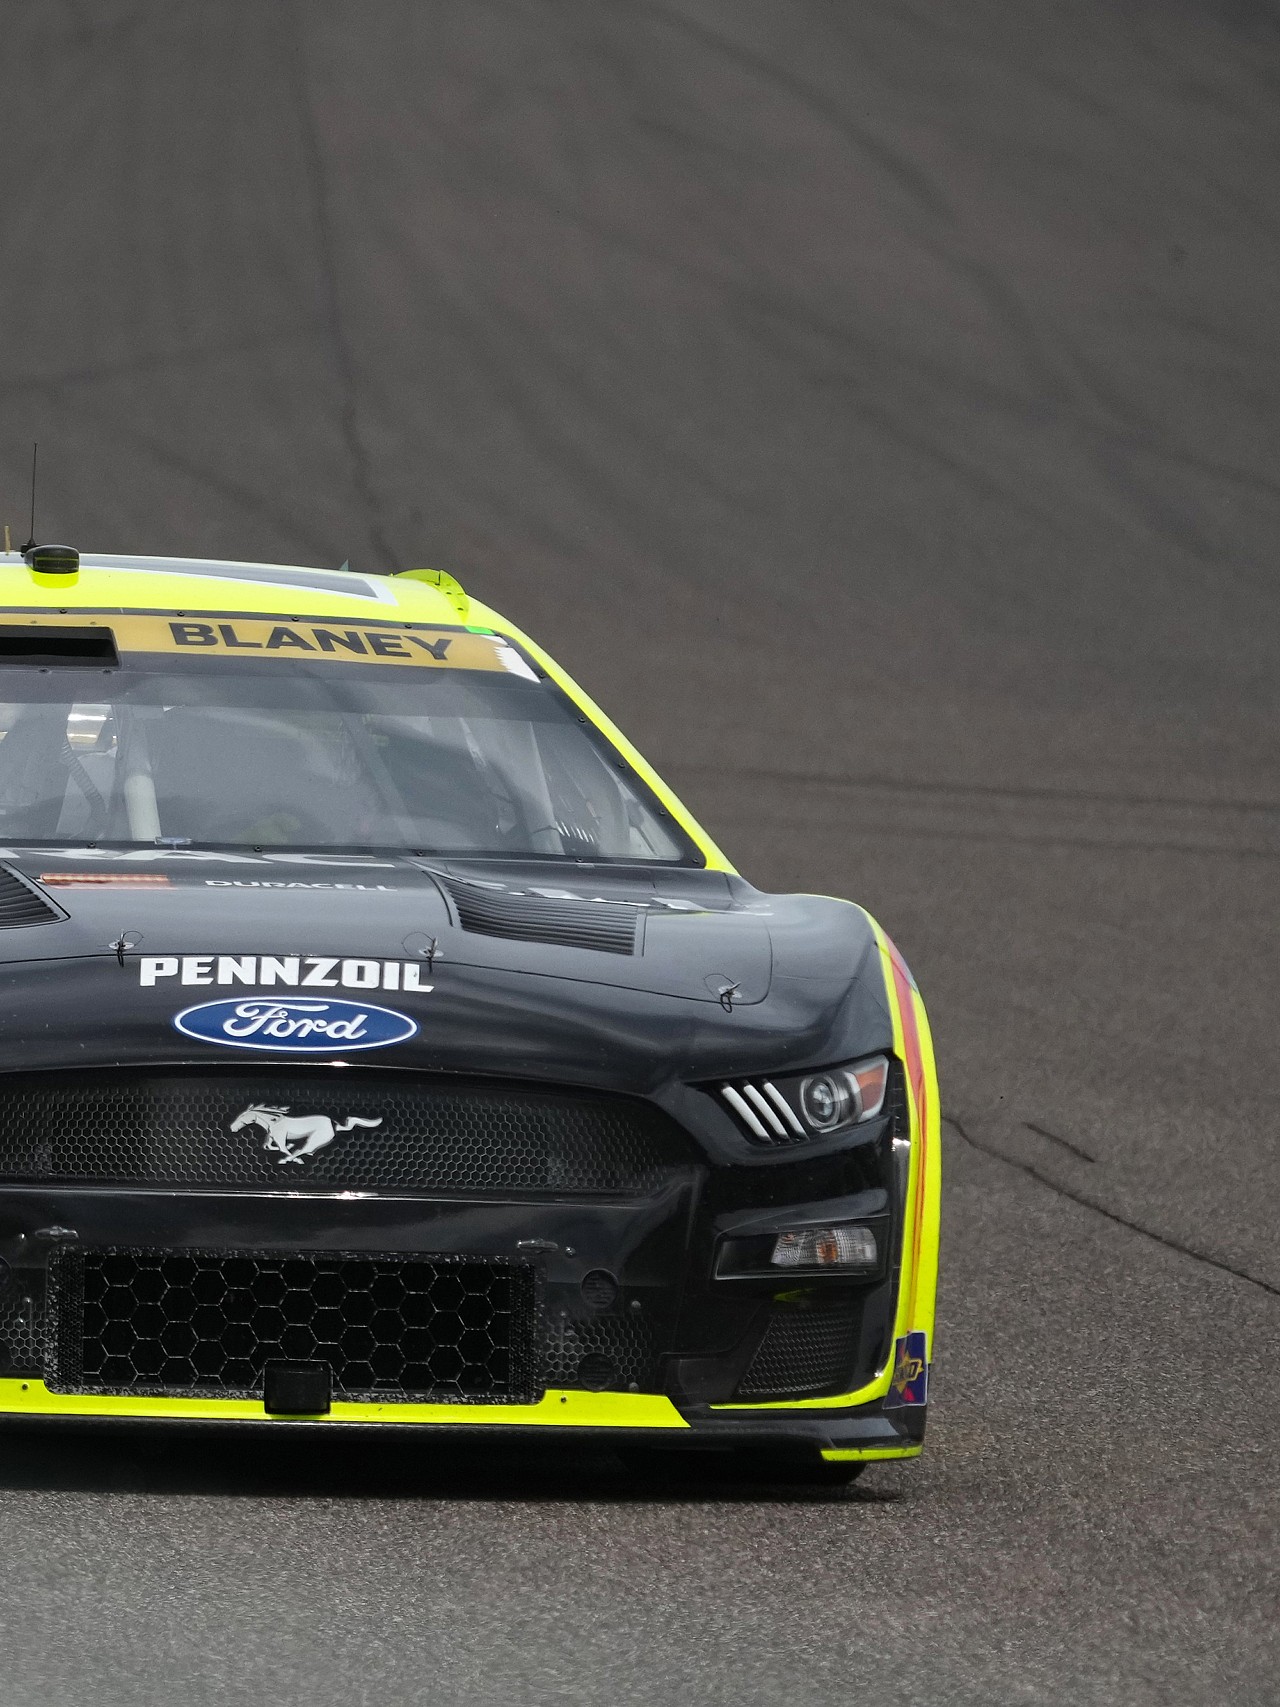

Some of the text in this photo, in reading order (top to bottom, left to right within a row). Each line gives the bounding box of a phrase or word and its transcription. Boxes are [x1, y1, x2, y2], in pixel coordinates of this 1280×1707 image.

[169, 622, 452, 660] BLANEY
[205, 880, 398, 892] DURACELL
[139, 956, 435, 993] PENNZOIL
[222, 1002, 369, 1041] Ford
